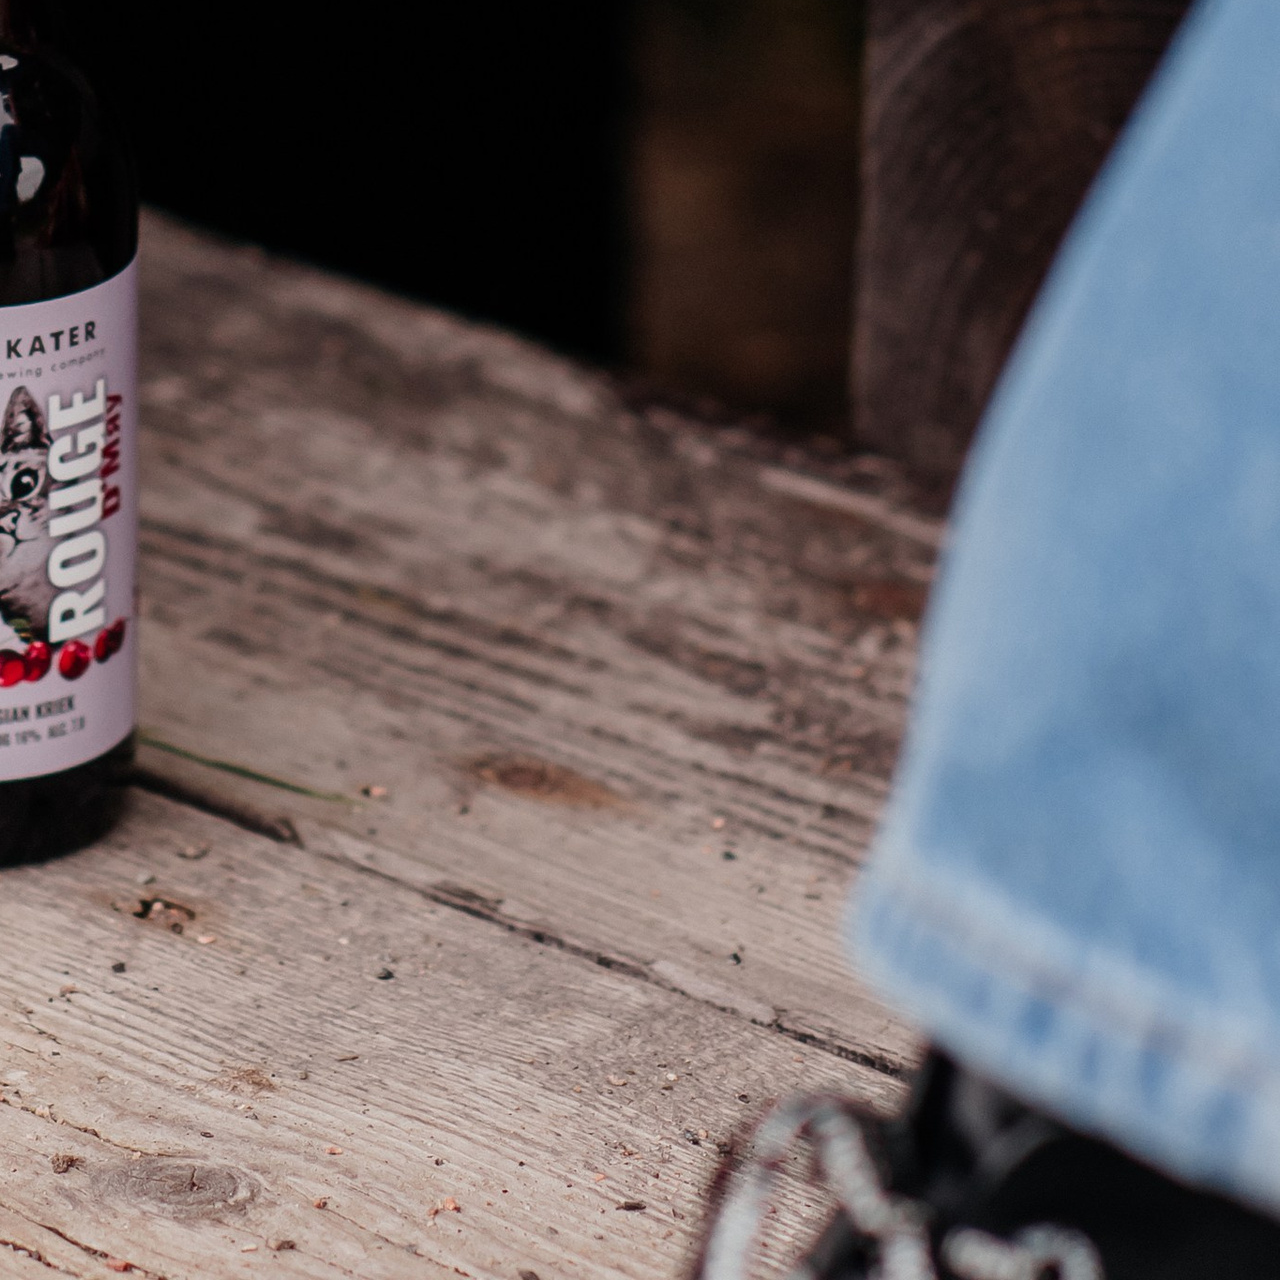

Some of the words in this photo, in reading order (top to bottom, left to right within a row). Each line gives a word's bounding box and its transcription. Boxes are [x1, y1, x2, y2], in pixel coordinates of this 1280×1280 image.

[6, 321, 97, 360] KATER
[50, 346, 106, 373] company
[47, 379, 106, 643] ROUGE
